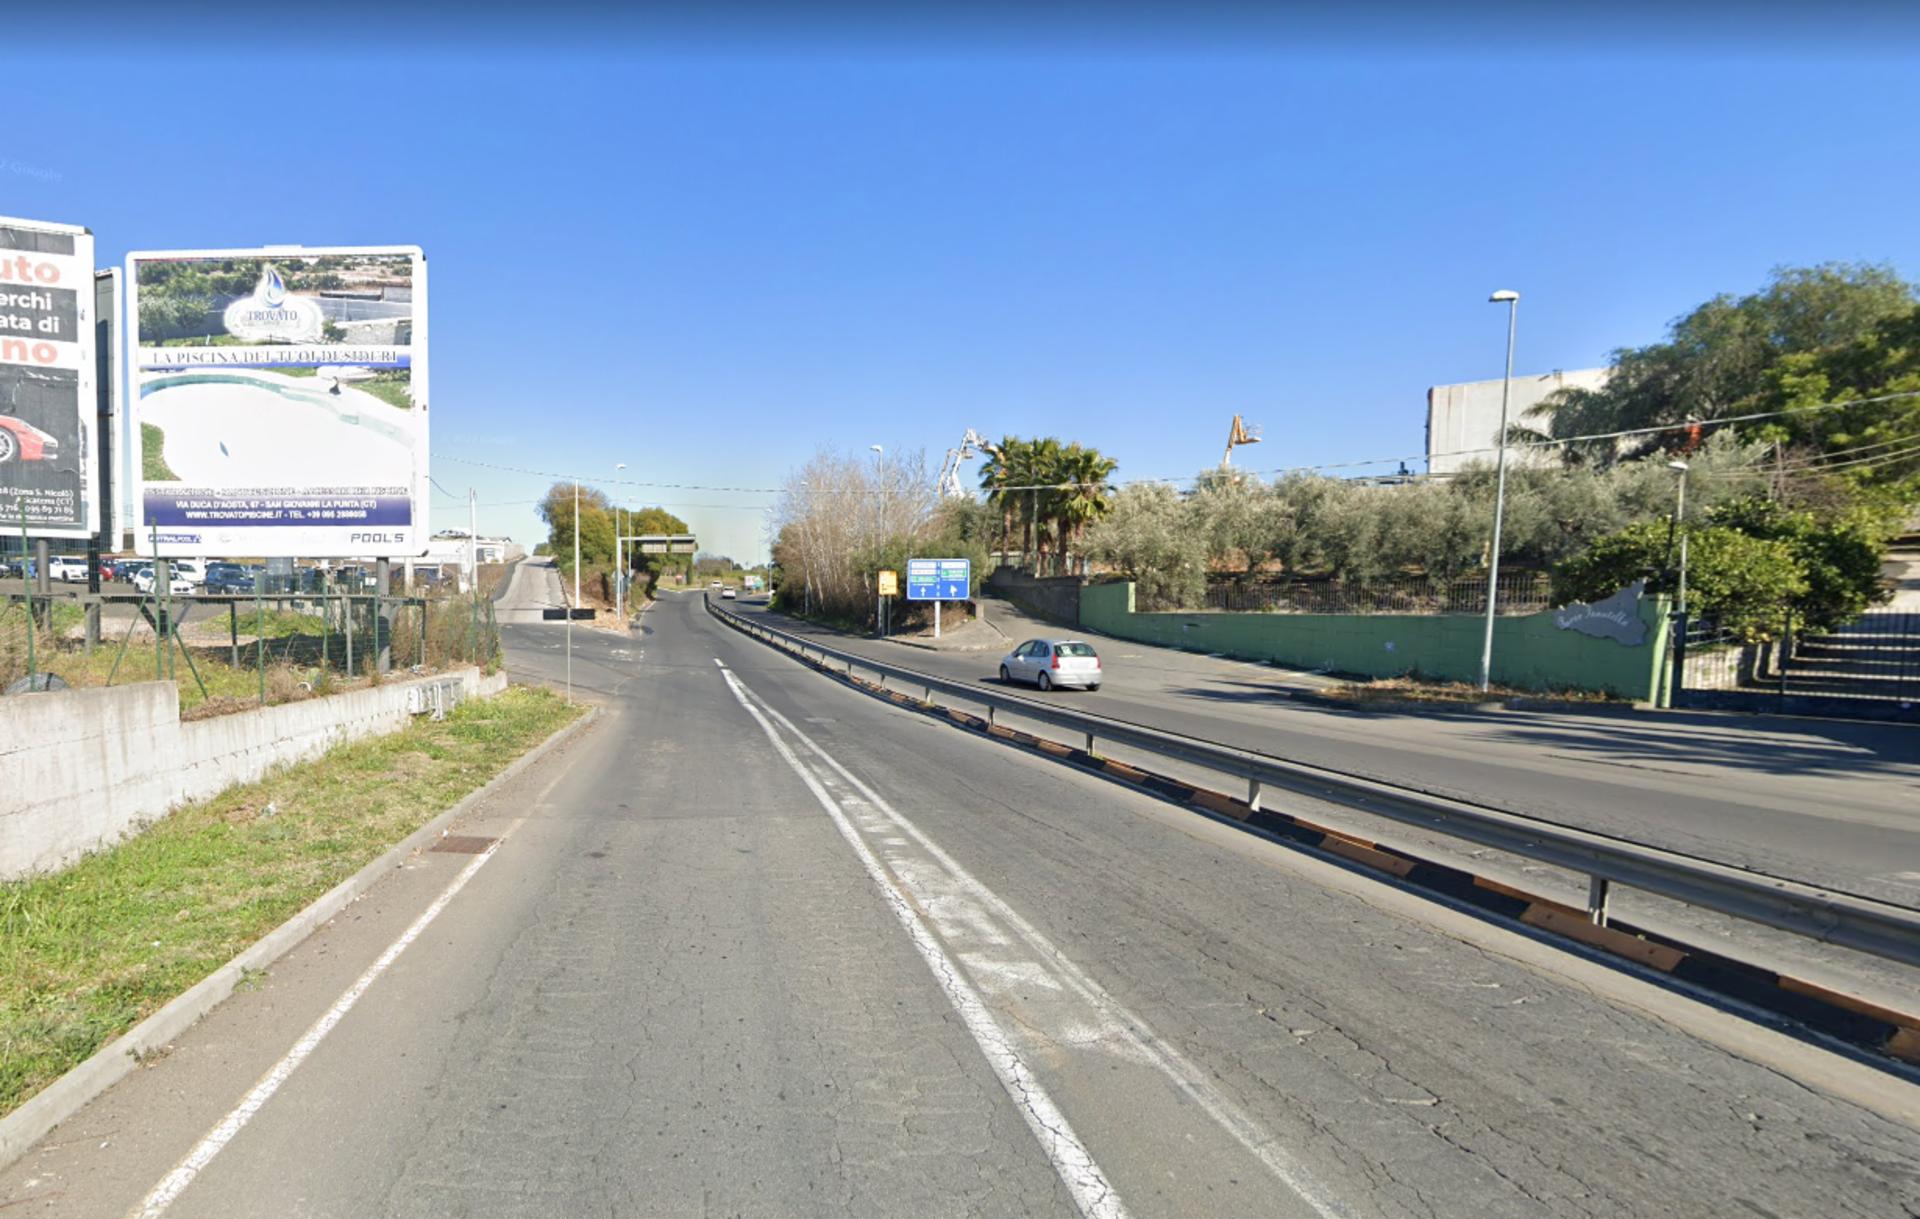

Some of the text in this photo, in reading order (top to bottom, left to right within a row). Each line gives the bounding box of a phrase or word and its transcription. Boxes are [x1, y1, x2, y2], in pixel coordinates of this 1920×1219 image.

[247, 310, 298, 321] TROVATO
[38, 316, 60, 334] di
[2, 340, 58, 365] no
[152, 352, 171, 364] LA
[177, 352, 238, 363] PISCINA
[277, 350, 316, 362] TUOI
[321, 350, 397, 362] DESIDERI
[176, 500, 189, 509] VIA
[190, 500, 212, 509] DUCA
[265, 500, 282, 509] SAN
[283, 500, 321, 509] GIOVANNI
[321, 500, 333, 509] LA
[333, 500, 359, 509] PUNTA
[360, 500, 377, 510] (CT)
